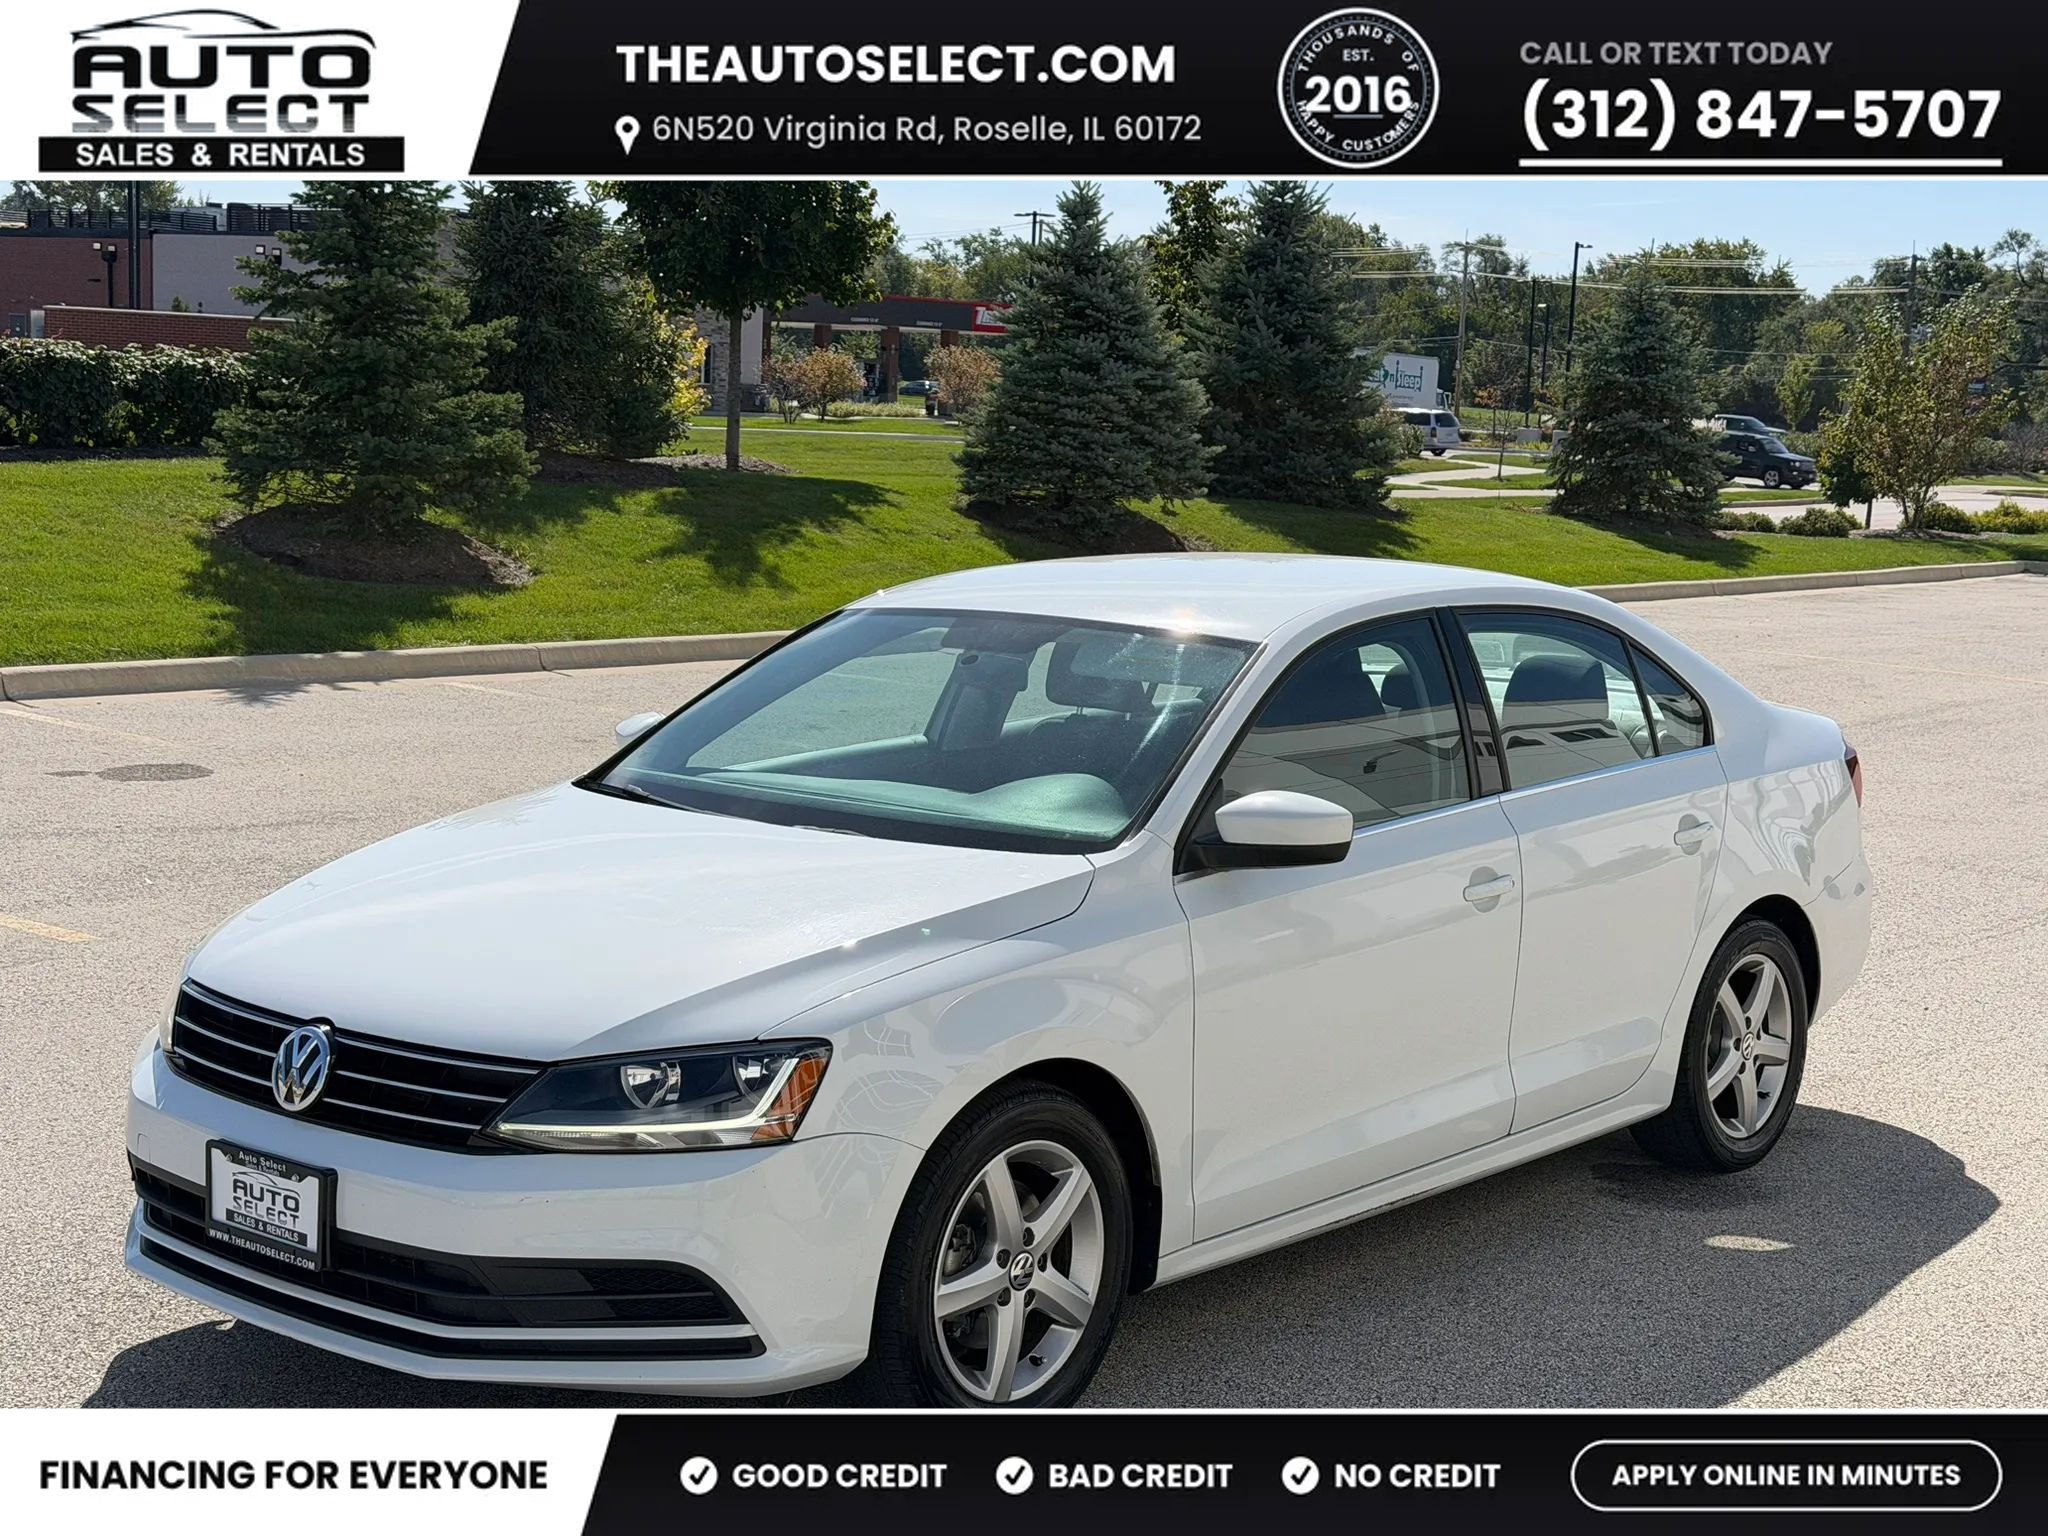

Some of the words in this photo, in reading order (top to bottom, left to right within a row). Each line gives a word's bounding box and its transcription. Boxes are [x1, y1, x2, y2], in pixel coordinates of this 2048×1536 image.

[239, 1151, 257, 1163] Auto
[260, 1157, 286, 1171] Select
[233, 1178, 300, 1213] AUTO
[233, 1195, 299, 1228] SELECT
[233, 1213, 256, 1228] SALES
[258, 1221, 264, 1231] &
[266, 1224, 299, 1242] RENTALS
[209, 1228, 316, 1271] WWW.THEAUTOSELECT.COM
